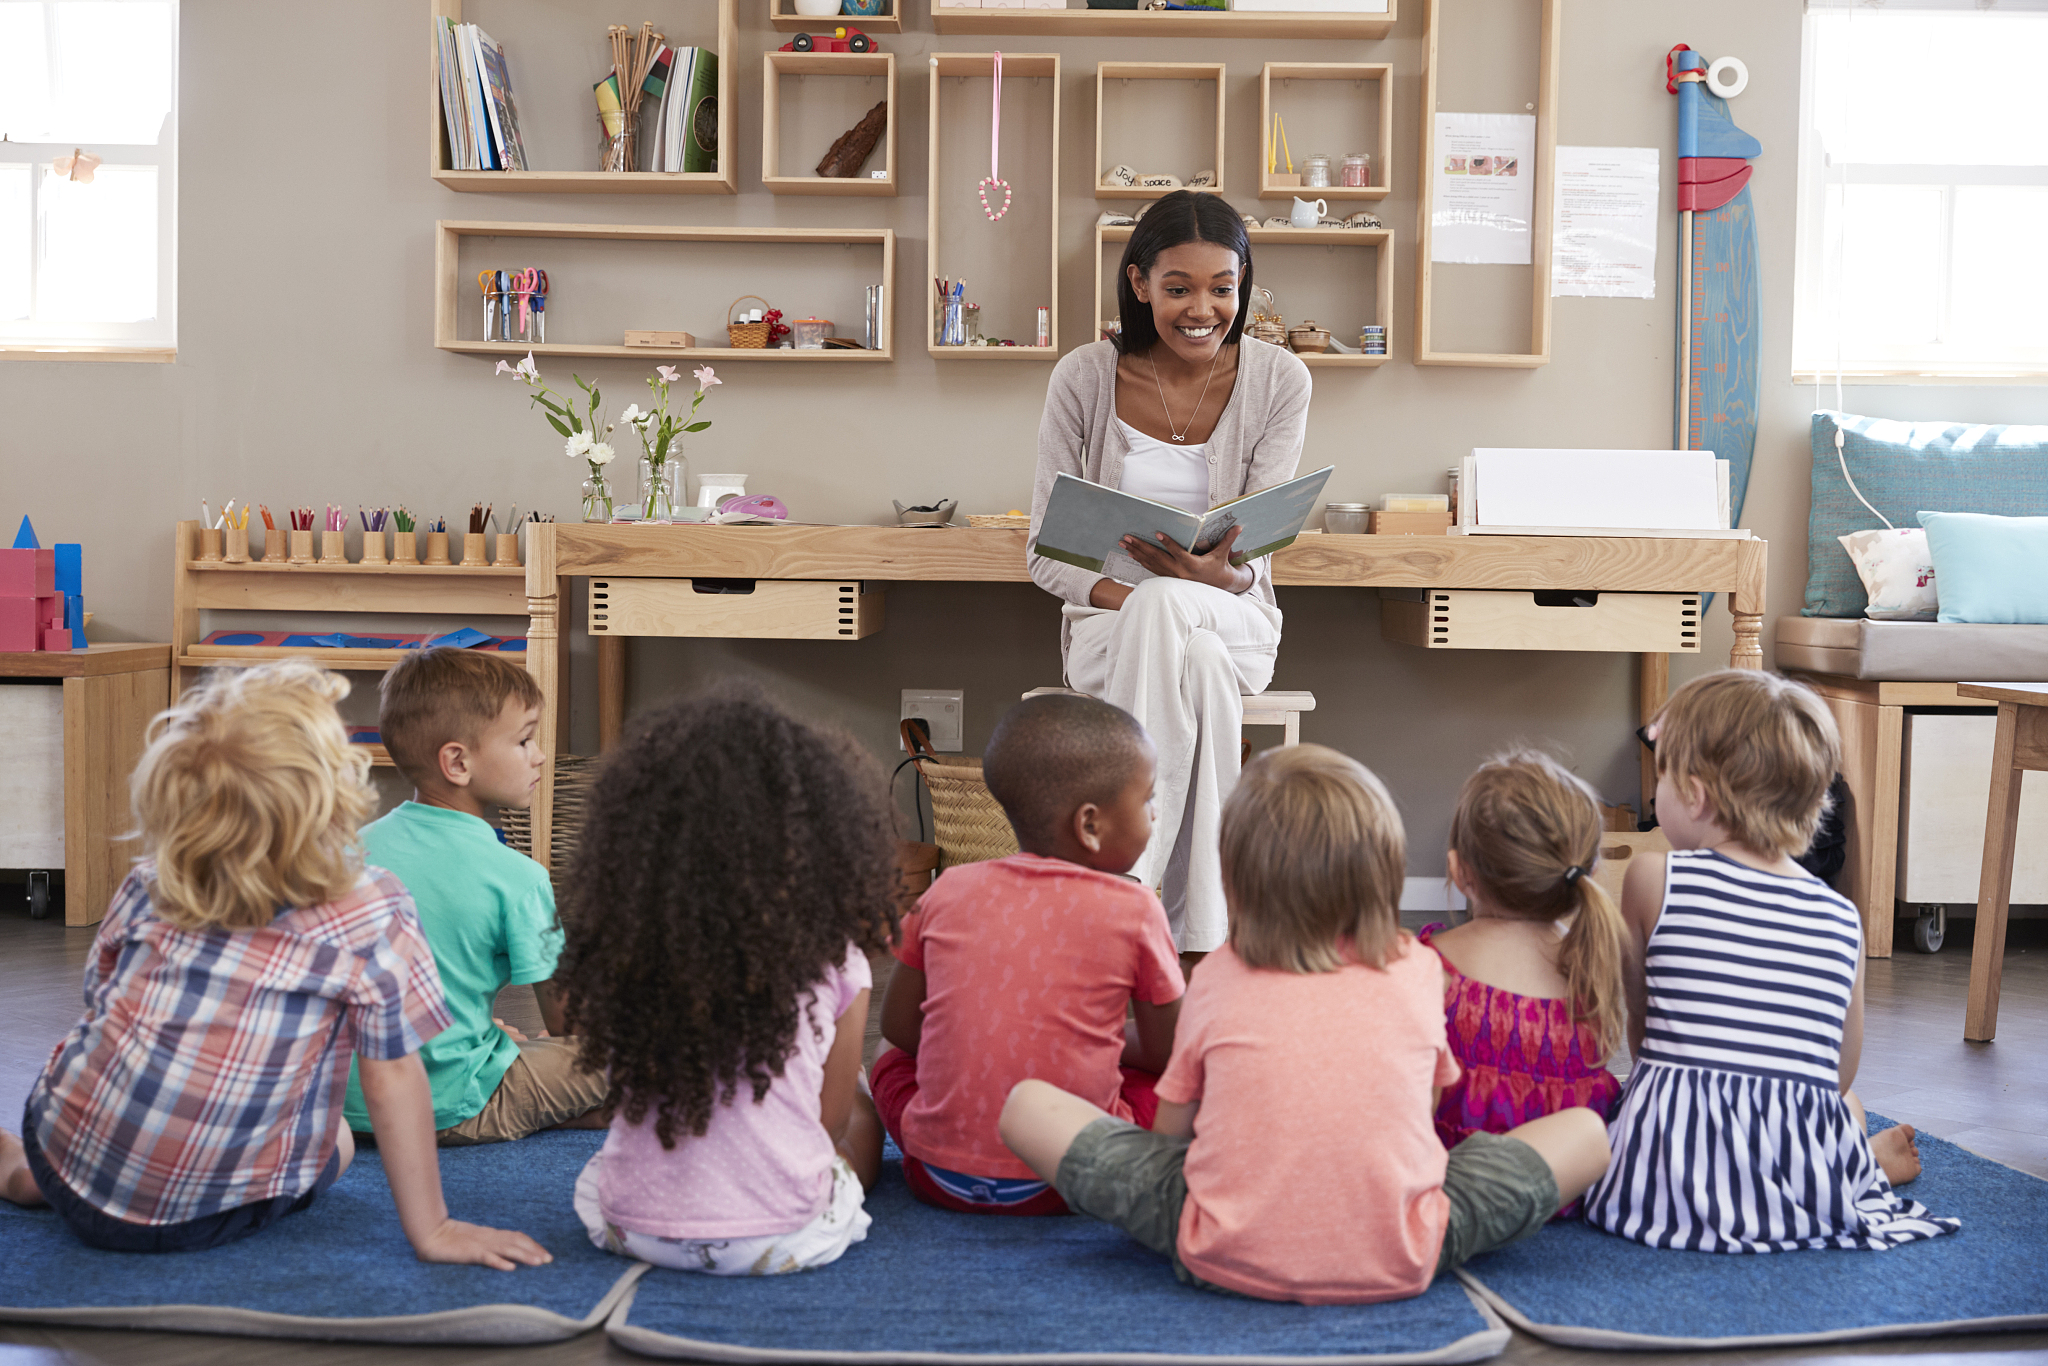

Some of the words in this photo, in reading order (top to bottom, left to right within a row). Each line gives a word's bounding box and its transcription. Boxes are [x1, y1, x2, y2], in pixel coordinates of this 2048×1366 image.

[1116, 167, 1135, 187] Joy
[1716, 212, 1730, 222] 140
[1318, 220, 1345, 229] umping
[1716, 262, 1729, 272] 130
[1715, 313, 1728, 322] 120
[1715, 363, 1727, 373] 110
[1713, 413, 1726, 423] 100
